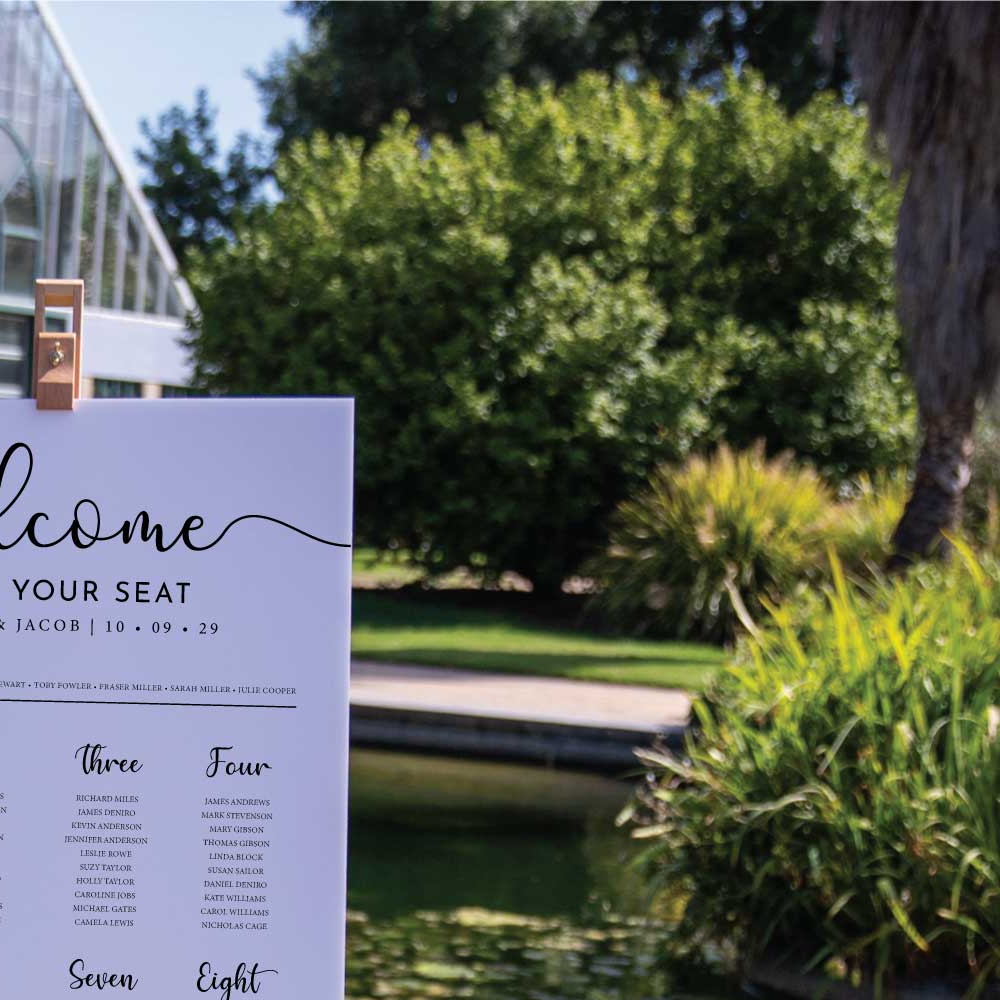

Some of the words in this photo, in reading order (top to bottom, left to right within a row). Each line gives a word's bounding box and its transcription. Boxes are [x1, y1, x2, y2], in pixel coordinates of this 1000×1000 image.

[11, 578, 99, 602] YOUR
[114, 580, 191, 604] SEAT
[16, 618, 80, 633] JACOB
[105, 620, 125, 633] 10
[151, 621, 172, 634] 09
[198, 622, 219, 635] 29
[33, 680, 56, 689] TOBY
[56, 680, 92, 690] FOWLER
[98, 681, 130, 690] FRASER
[131, 682, 162, 691] MILLER
[169, 683, 198, 692] SARAH
[199, 683, 231, 693] MILLER
[237, 684, 261, 693] JULIE
[261, 684, 296, 694] COOPER
[206, 746, 272, 778] Four
[75, 794, 113, 802] RICHARD
[113, 794, 139, 803] MILES
[204, 797, 230, 805] JAMES
[229, 797, 271, 806] ANDREWS
[200, 810, 225, 819] MARK
[225, 811, 273, 820] STEVENSON
[70, 821, 97, 829] KEVIN
[96, 822, 142, 831] ANDERSON
[208, 824, 233, 833] MARY
[232, 825, 264, 834] GIBSON
[202, 838, 238, 847] THOMAS
[238, 839, 270, 848] GIBSON
[79, 848, 107, 857] LESLIE
[107, 849, 132, 858] ROWE
[208, 852, 235, 861] LINDA
[235, 853, 263, 861] BLOCK
[79, 862, 100, 871] SUZY
[100, 863, 132, 872] TAYLOR
[75, 876, 103, 885] HOLLY
[103, 877, 135, 886] TAYLOR
[203, 879, 234, 888] DANIEL
[234, 880, 268, 889] DENIRO
[73, 890, 116, 899] CAROLINE
[116, 891, 136, 899] JOBS
[72, 904, 110, 913] MICHAEL
[110, 904, 137, 913] GATES
[73, 918, 108, 926] CAMELA
[109, 918, 134, 927] LEWIS
[200, 921, 244, 930] NICHOLAS
[244, 921, 268, 930] CAGE
[69, 959, 138, 991] Seven
